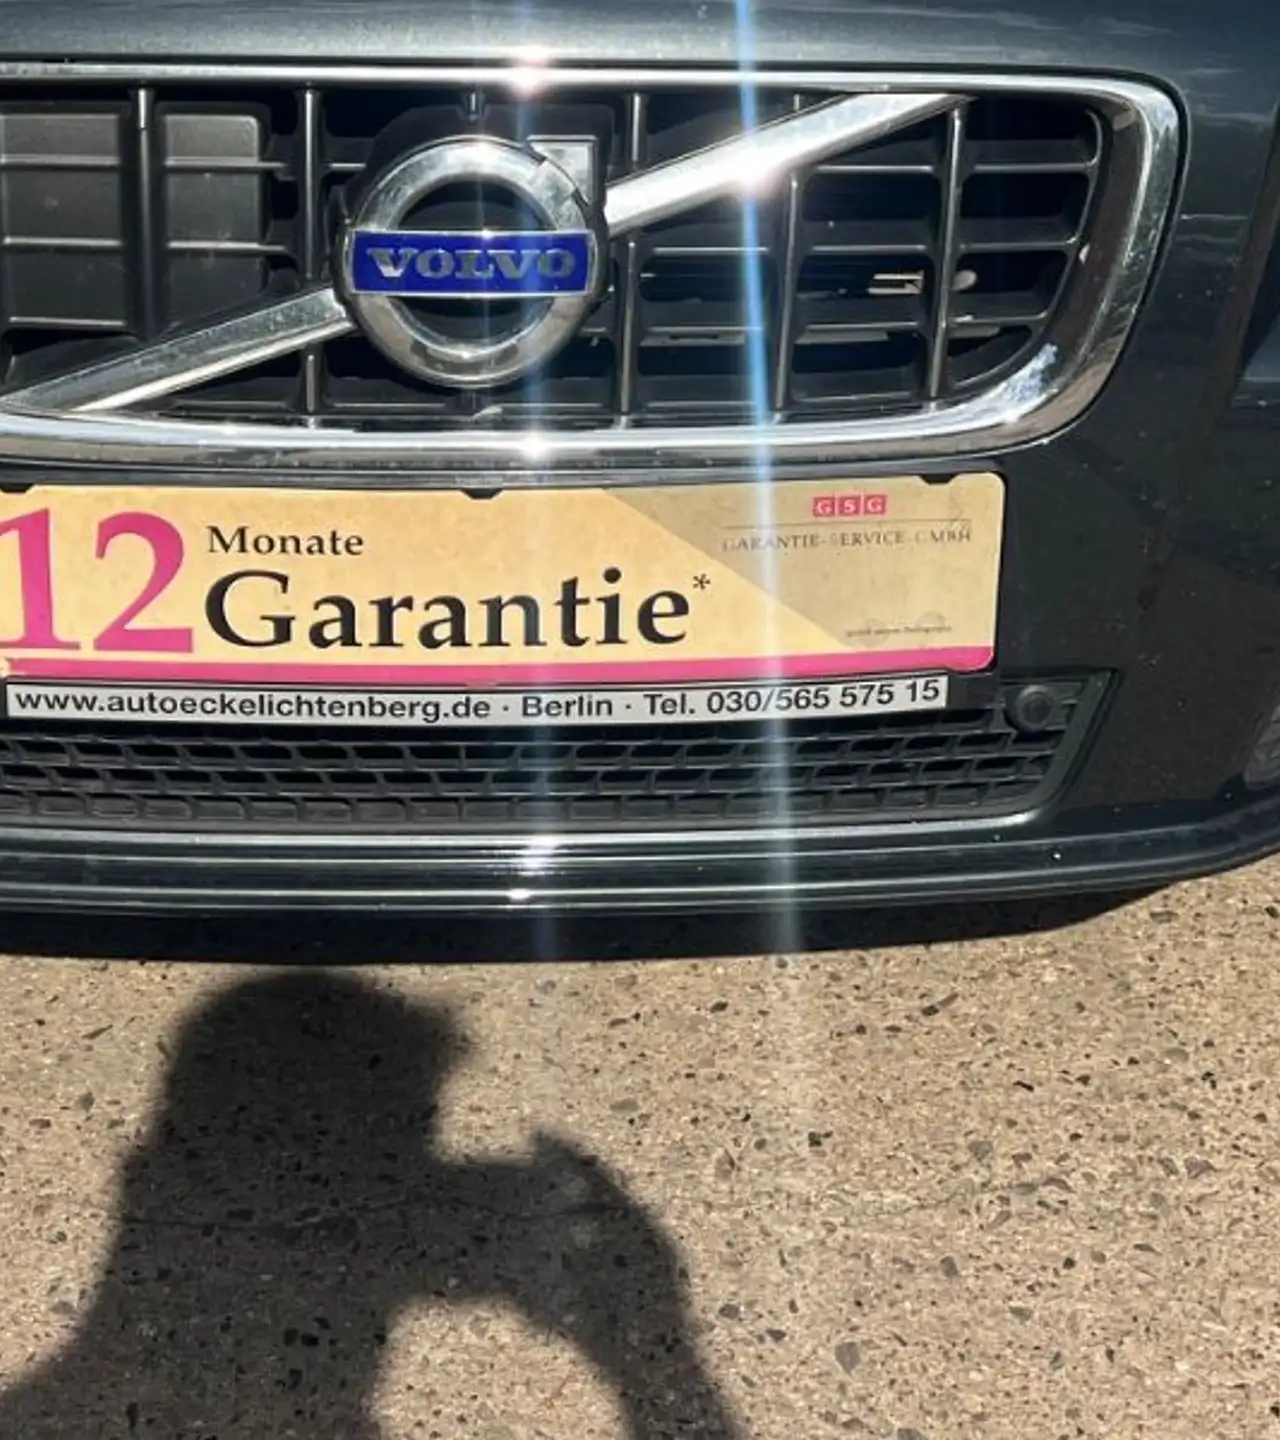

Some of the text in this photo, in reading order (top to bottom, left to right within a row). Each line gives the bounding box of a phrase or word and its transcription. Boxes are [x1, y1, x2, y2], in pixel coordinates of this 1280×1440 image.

[366, 247, 576, 279] VOLVO
[814, 495, 886, 516] GSG
[206, 524, 365, 556] Monate
[15, 678, 940, 723] www.autoeckelichtenberg.de Berlin Tel. 030/565 575 15
